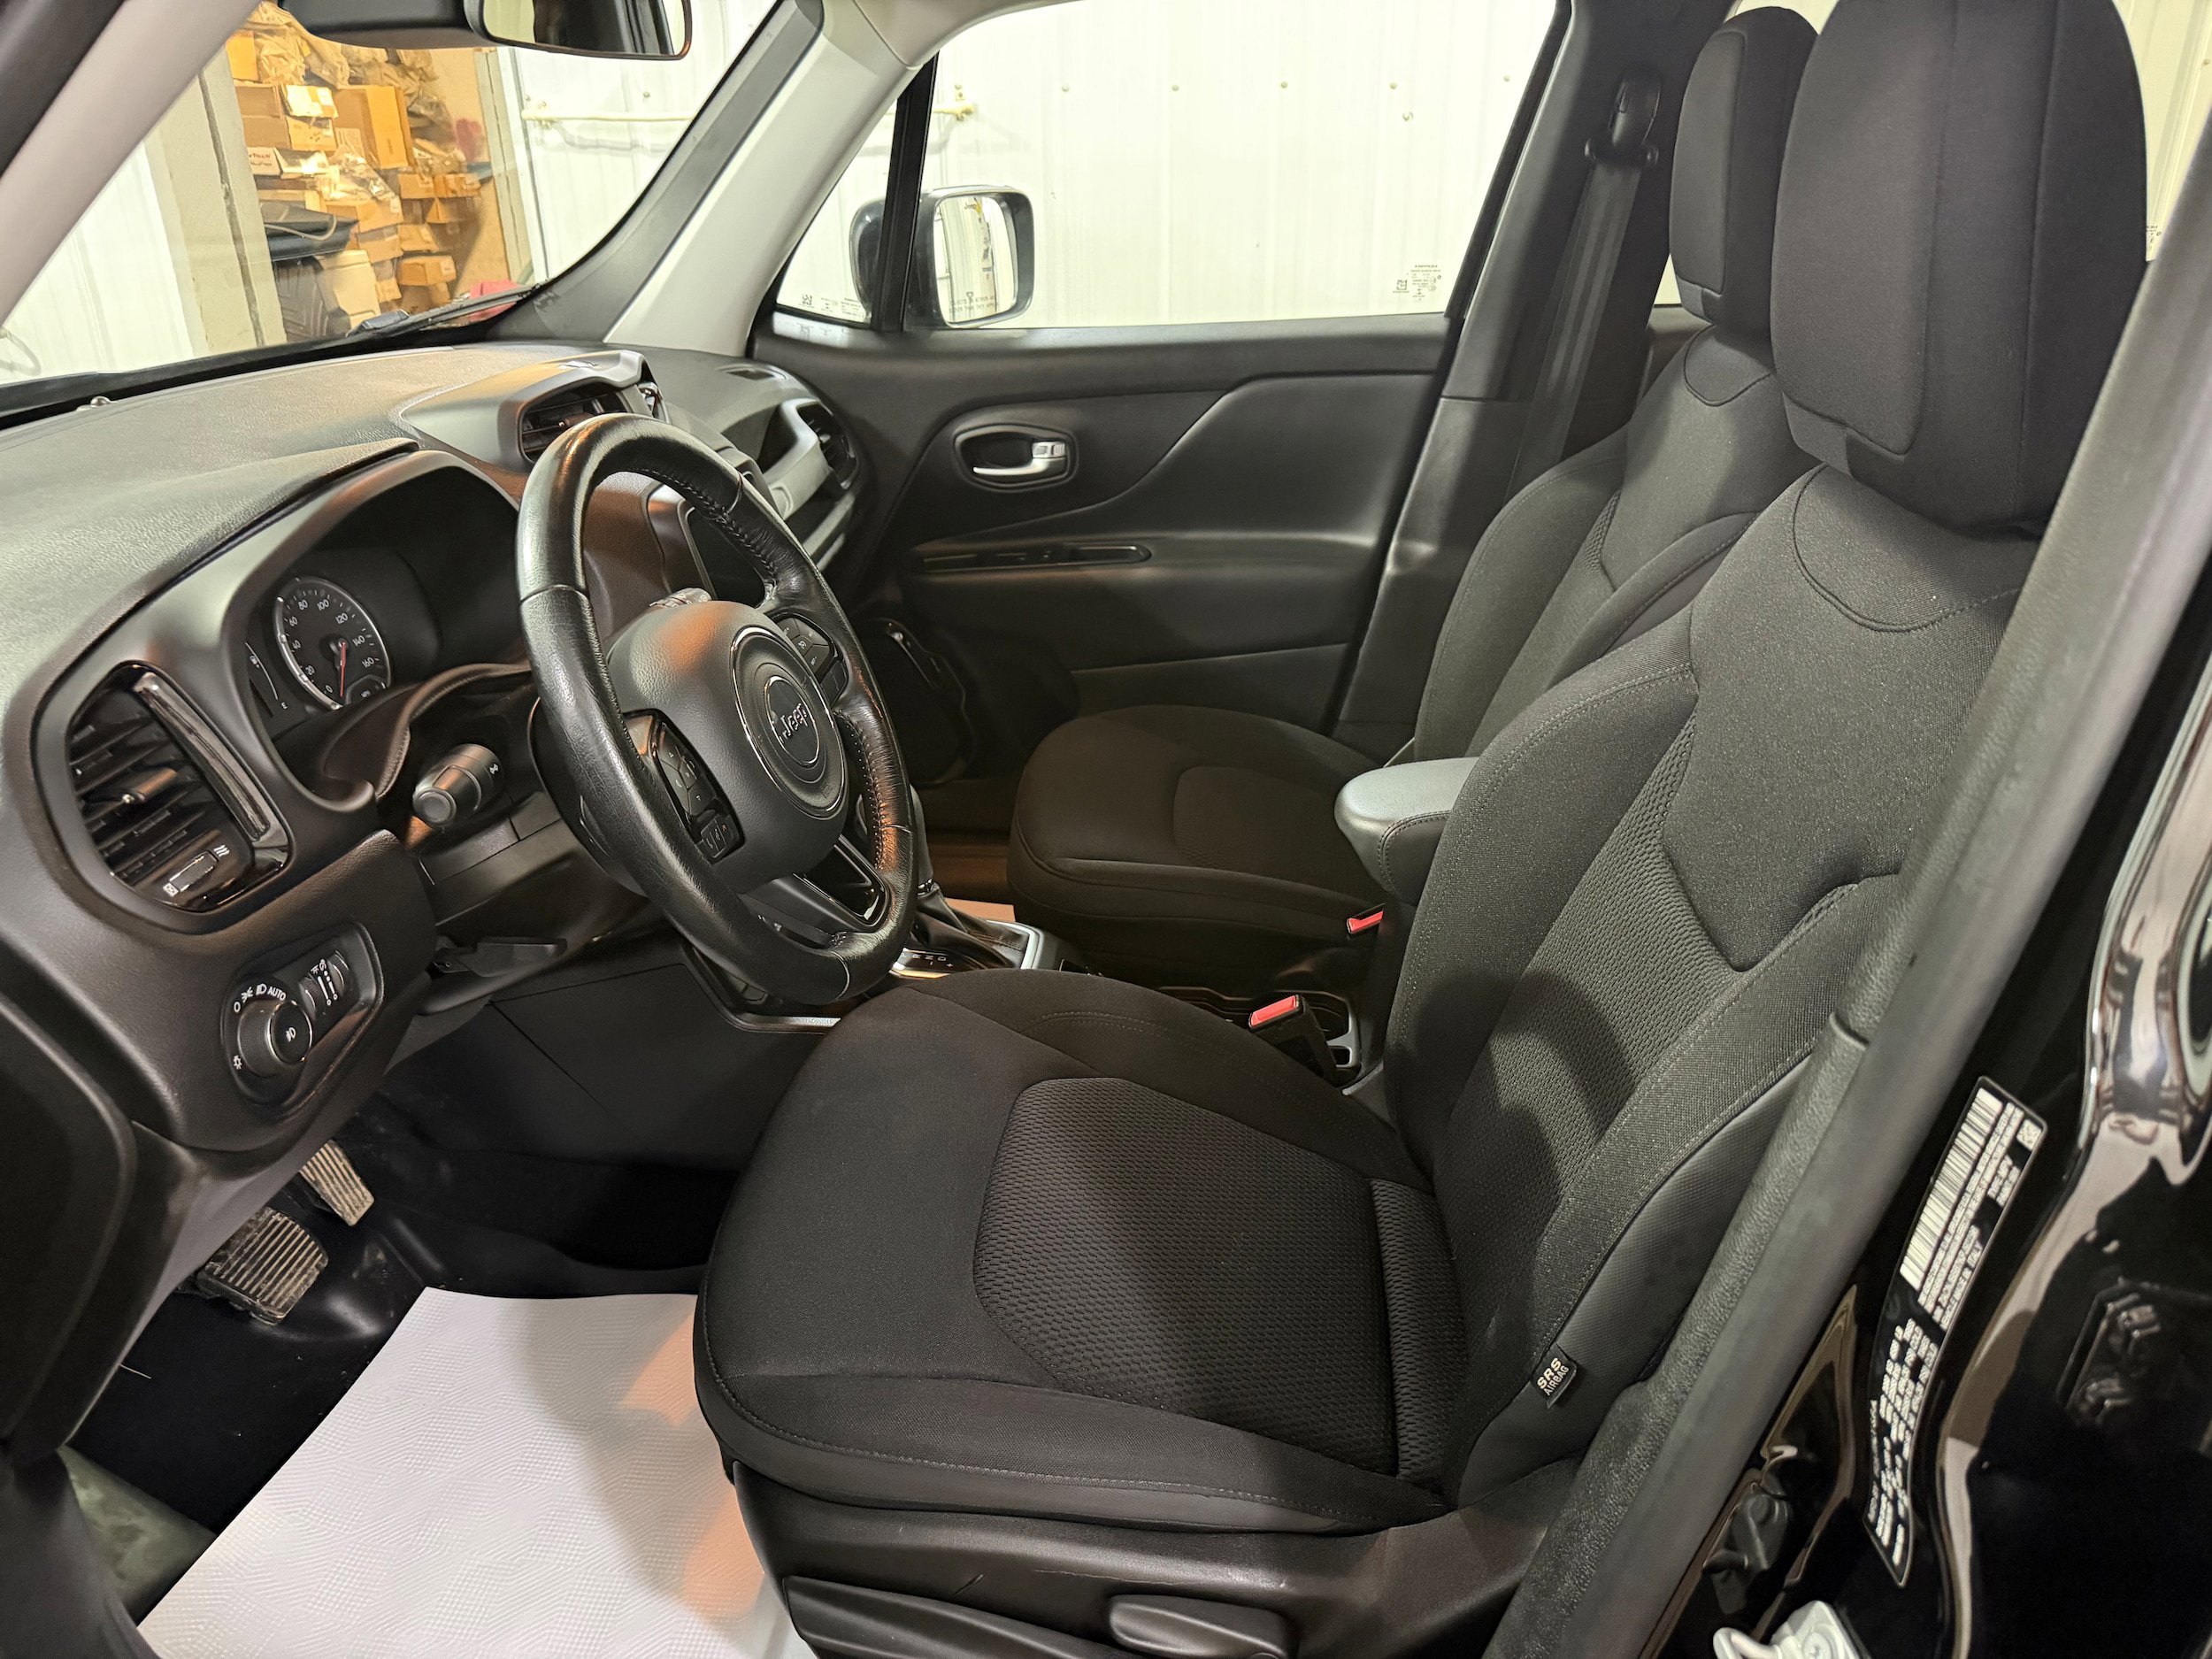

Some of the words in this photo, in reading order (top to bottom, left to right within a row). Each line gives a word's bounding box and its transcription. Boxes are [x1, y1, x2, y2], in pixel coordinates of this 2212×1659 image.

[298, 600, 308, 610] 80
[317, 599, 329, 611] 100
[289, 616, 297, 626] 60
[336, 613, 349, 624] 120
[292, 641, 301, 649] 40
[352, 635, 365, 646] 140
[362, 657, 374, 668] 160
[306, 665, 315, 676] 20
[780, 703, 808, 739] Jeep
[267, 987, 287, 1001] AUTO
[1965, 1240, 1982, 1269] ITALY
[1538, 1357, 1561, 1389] SRS
[1543, 1365, 1570, 1396] AIRBAG
